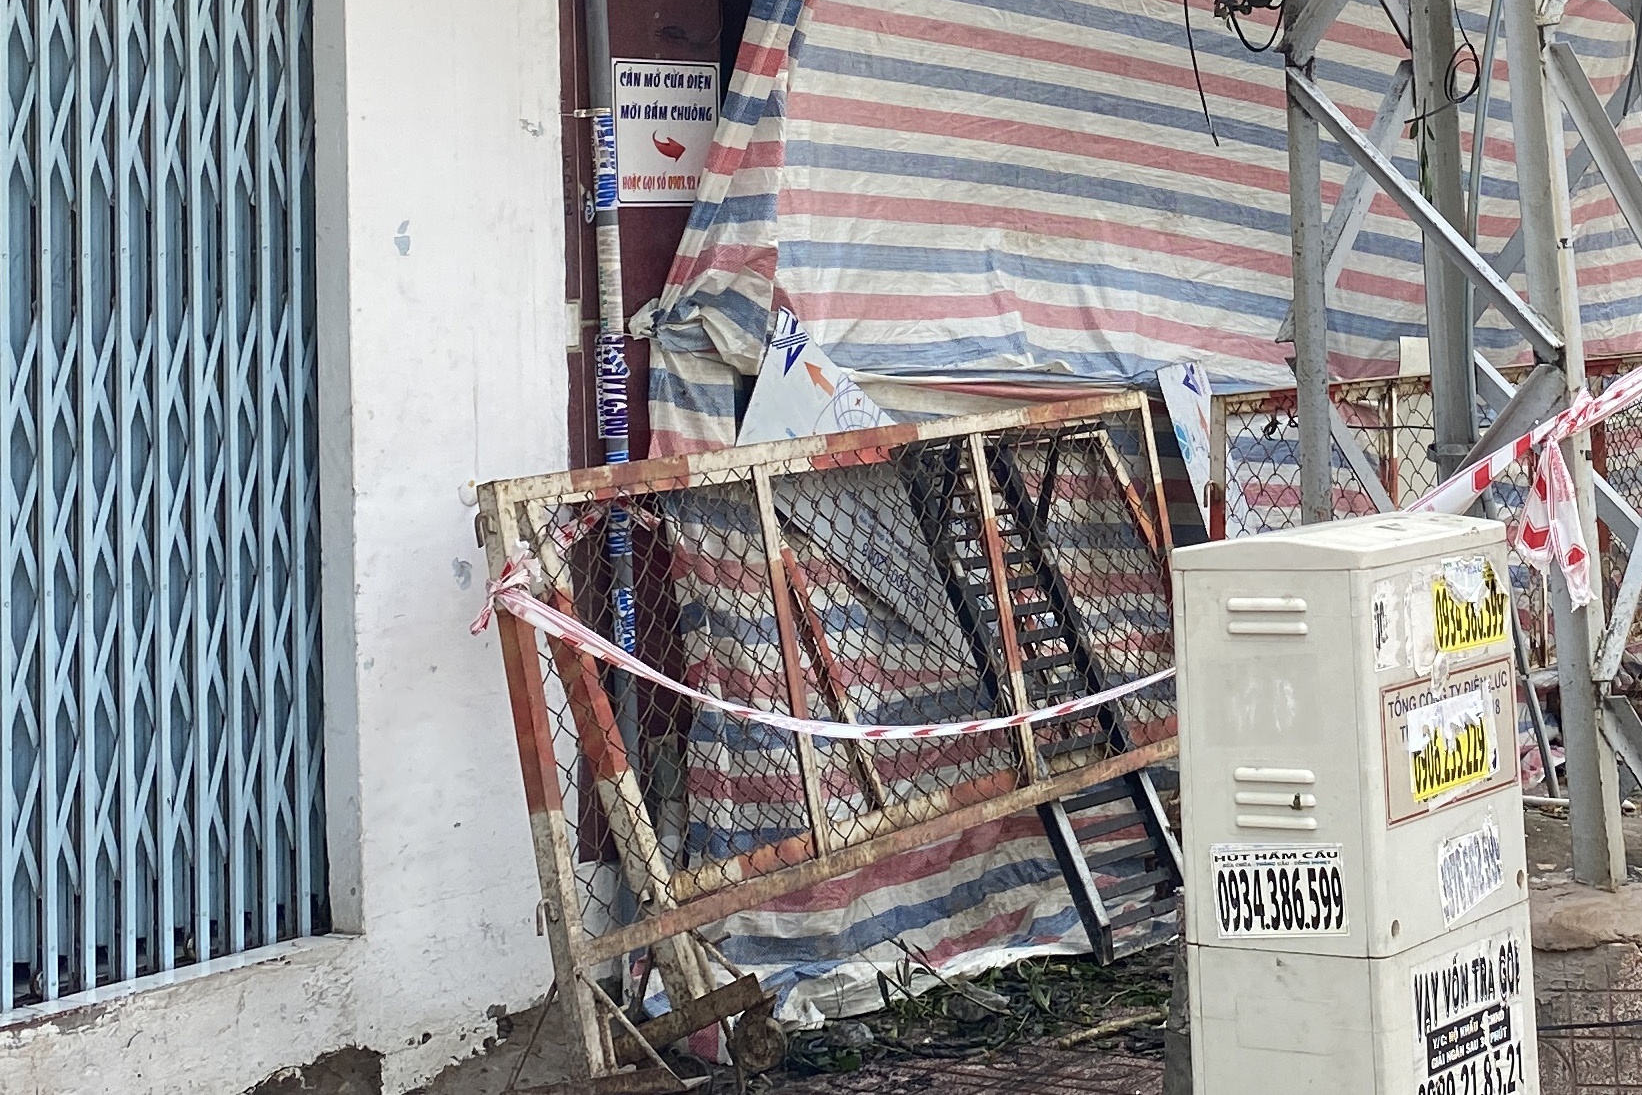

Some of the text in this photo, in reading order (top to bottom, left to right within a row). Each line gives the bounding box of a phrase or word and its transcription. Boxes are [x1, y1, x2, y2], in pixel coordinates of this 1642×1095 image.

[619, 67, 713, 93] CẦN MỞ CỬA ĐIỆN
[620, 99, 713, 122] MỜI BẤM CHUÔNG
[643, 175, 656, 193] GỌI
[656, 171, 667, 190] SỐ
[1387, 691, 1417, 720] TỔNG
[1214, 853, 1251, 863] HÚT
[1217, 866, 1344, 932] 0934.386.599
[1413, 969, 1439, 1044] VAY
[1441, 952, 1469, 1019] VỐN
